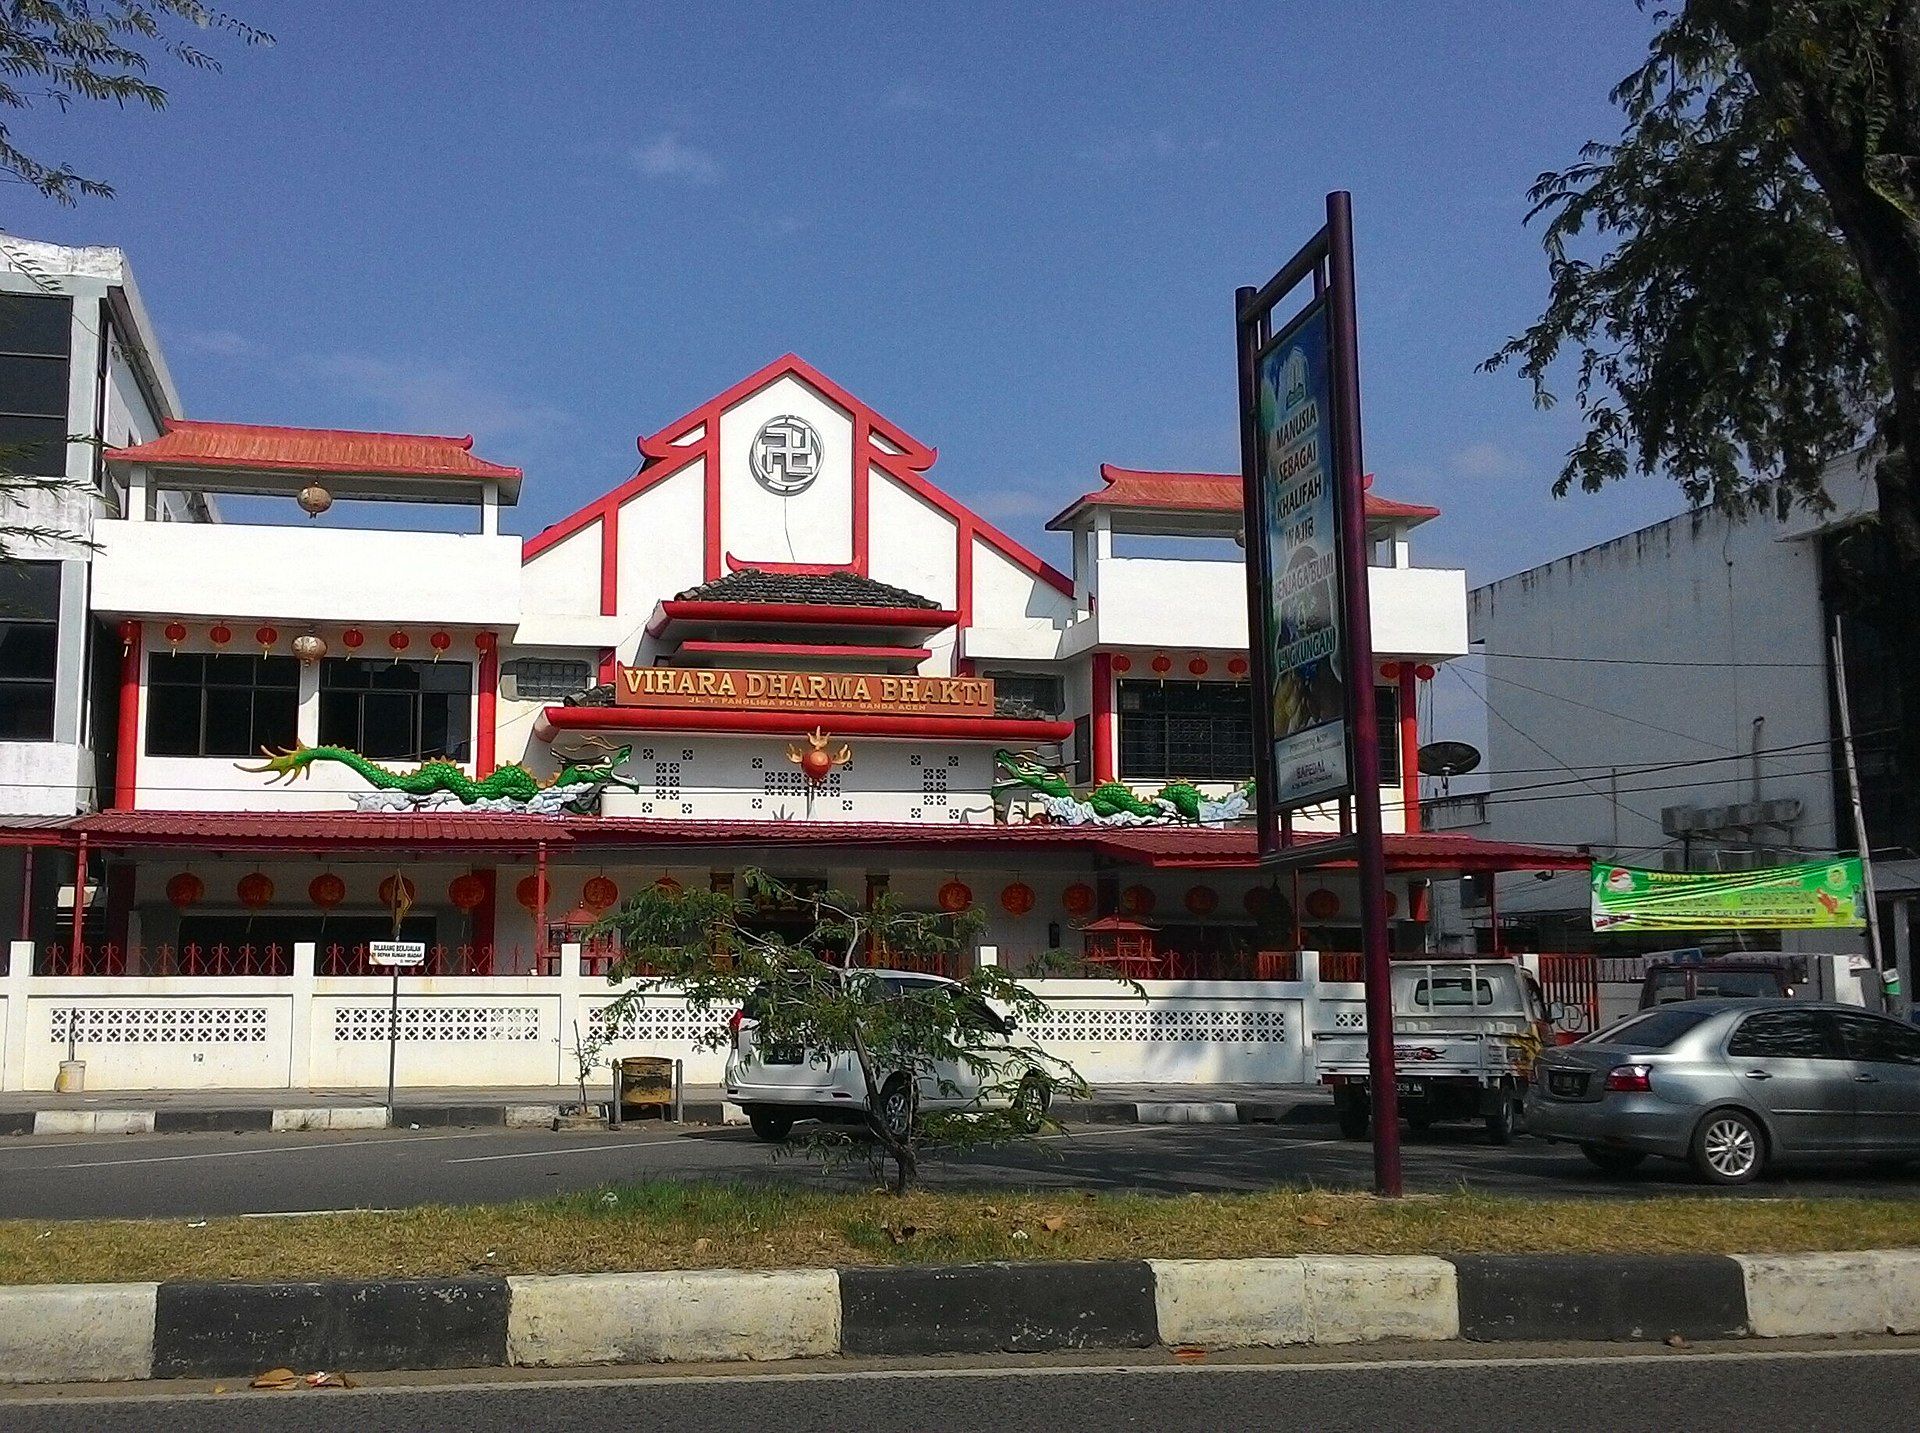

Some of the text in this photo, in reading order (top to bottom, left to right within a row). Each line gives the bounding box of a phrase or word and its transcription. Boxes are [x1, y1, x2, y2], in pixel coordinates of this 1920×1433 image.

[1276, 403, 1317, 450] MANUSIA
[1278, 440, 1316, 484] SEBAGAI
[1276, 473, 1322, 520] KHALIFAH
[1285, 516, 1314, 548] WAJIB
[623, 669, 988, 706] VIHARA DHARMA BHAKTI
[721, 698, 776, 706] PANGLIMA
[860, 703, 894, 711] BANDA
[397, 944, 421, 952] BERJUALAN
